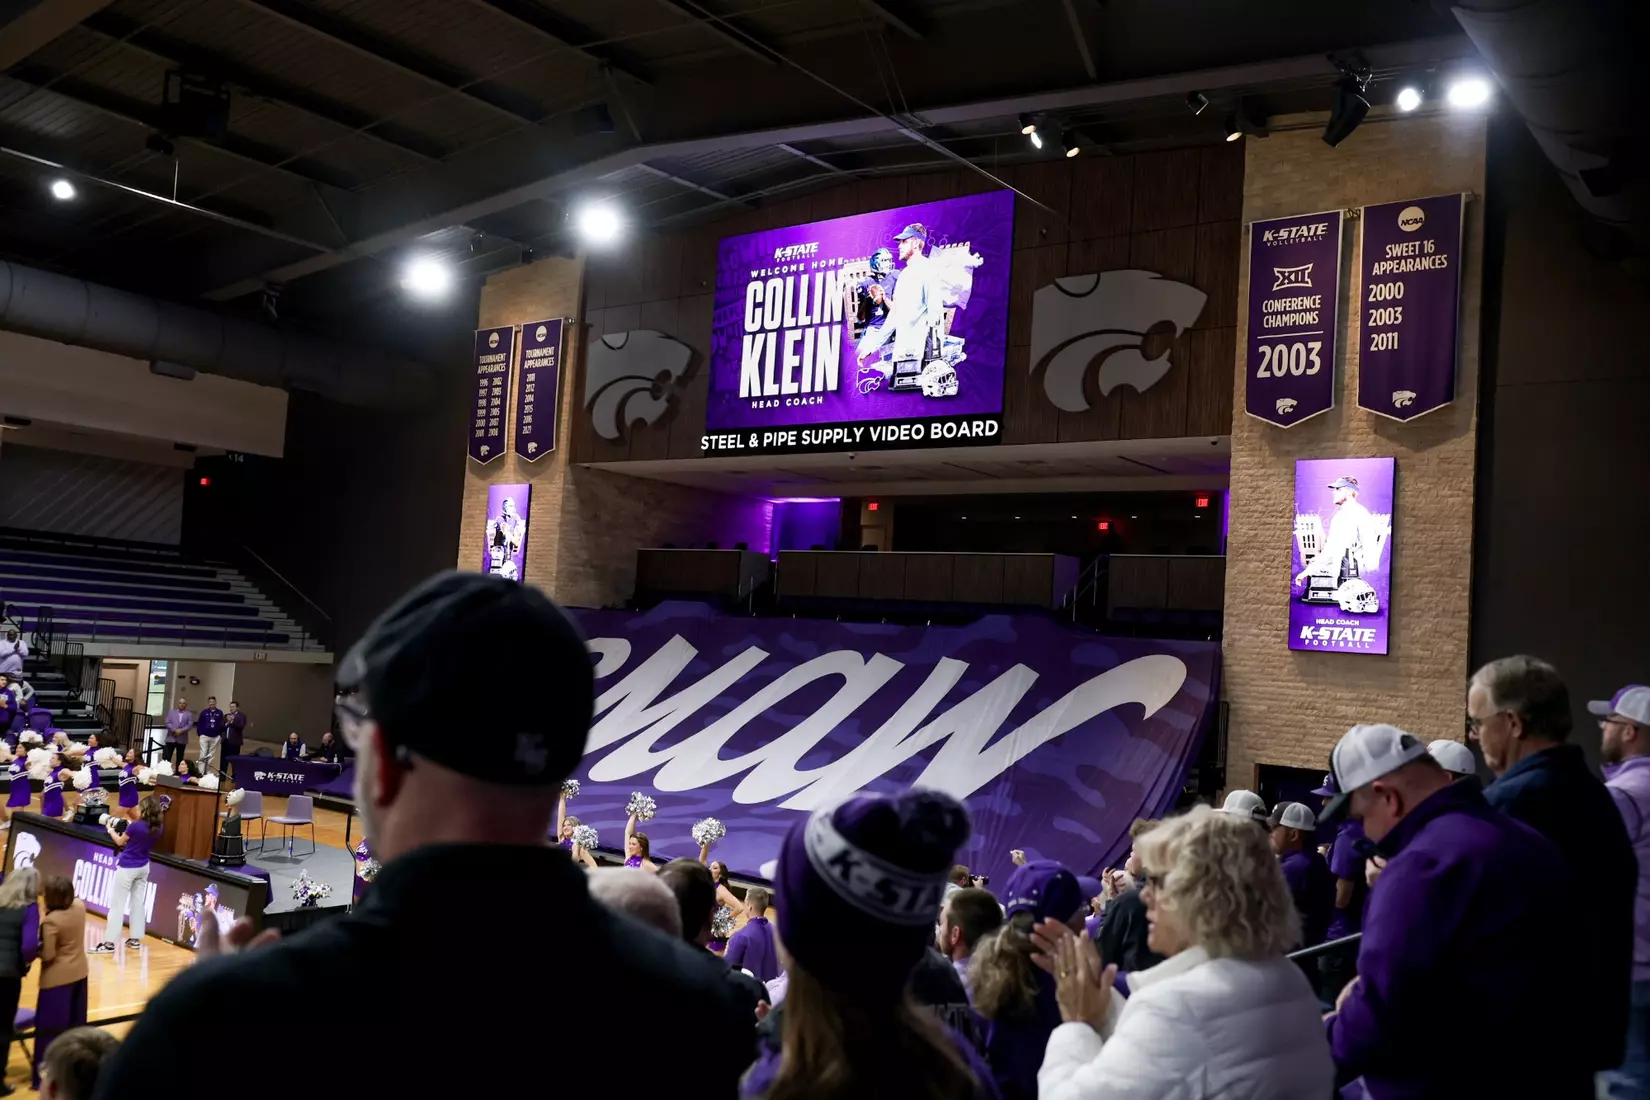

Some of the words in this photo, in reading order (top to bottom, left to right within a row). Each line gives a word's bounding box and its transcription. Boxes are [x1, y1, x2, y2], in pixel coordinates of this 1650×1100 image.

[1400, 217, 1424, 226] NCAA
[1262, 222, 1329, 242] K-STATE
[1266, 235, 1323, 247] VOLLEYBALL
[1385, 240, 1421, 258] SWEET
[1423, 239, 1435, 254] 16
[774, 242, 819, 259] K-STATE
[776, 253, 815, 263] FOOTBALL
[750, 263, 805, 279] WELCOME
[811, 257, 844, 269] HOME
[1372, 254, 1448, 276] APPEARANCES
[1368, 281, 1405, 302] 2000
[744, 269, 844, 332] COLLIN
[1262, 295, 1322, 313] CONFERENCE
[1263, 311, 1319, 328] CHAMPIONS
[1368, 306, 1403, 326] 2003
[1369, 332, 1399, 351] 2011
[526, 347, 554, 358] TOURNAMENT
[739, 324, 842, 398] KLEIN
[1256, 341, 1322, 378] 2003
[524, 357, 554, 369] APPEARANCES
[751, 400, 780, 409] HEAD
[785, 396, 823, 406] COACH
[700, 434, 745, 450] STEEL
[748, 433, 759, 447] &
[763, 430, 798, 447] PIPE
[801, 427, 864, 445] SUPPLY
[870, 423, 925, 442] VIDEO
[930, 420, 999, 440] BOARD
[1299, 625, 1377, 642] K-STATE
[1305, 639, 1369, 648] FOOTBALL
[267, 771, 305, 781] K-STATE
[93, 852, 113, 866] HEAD
